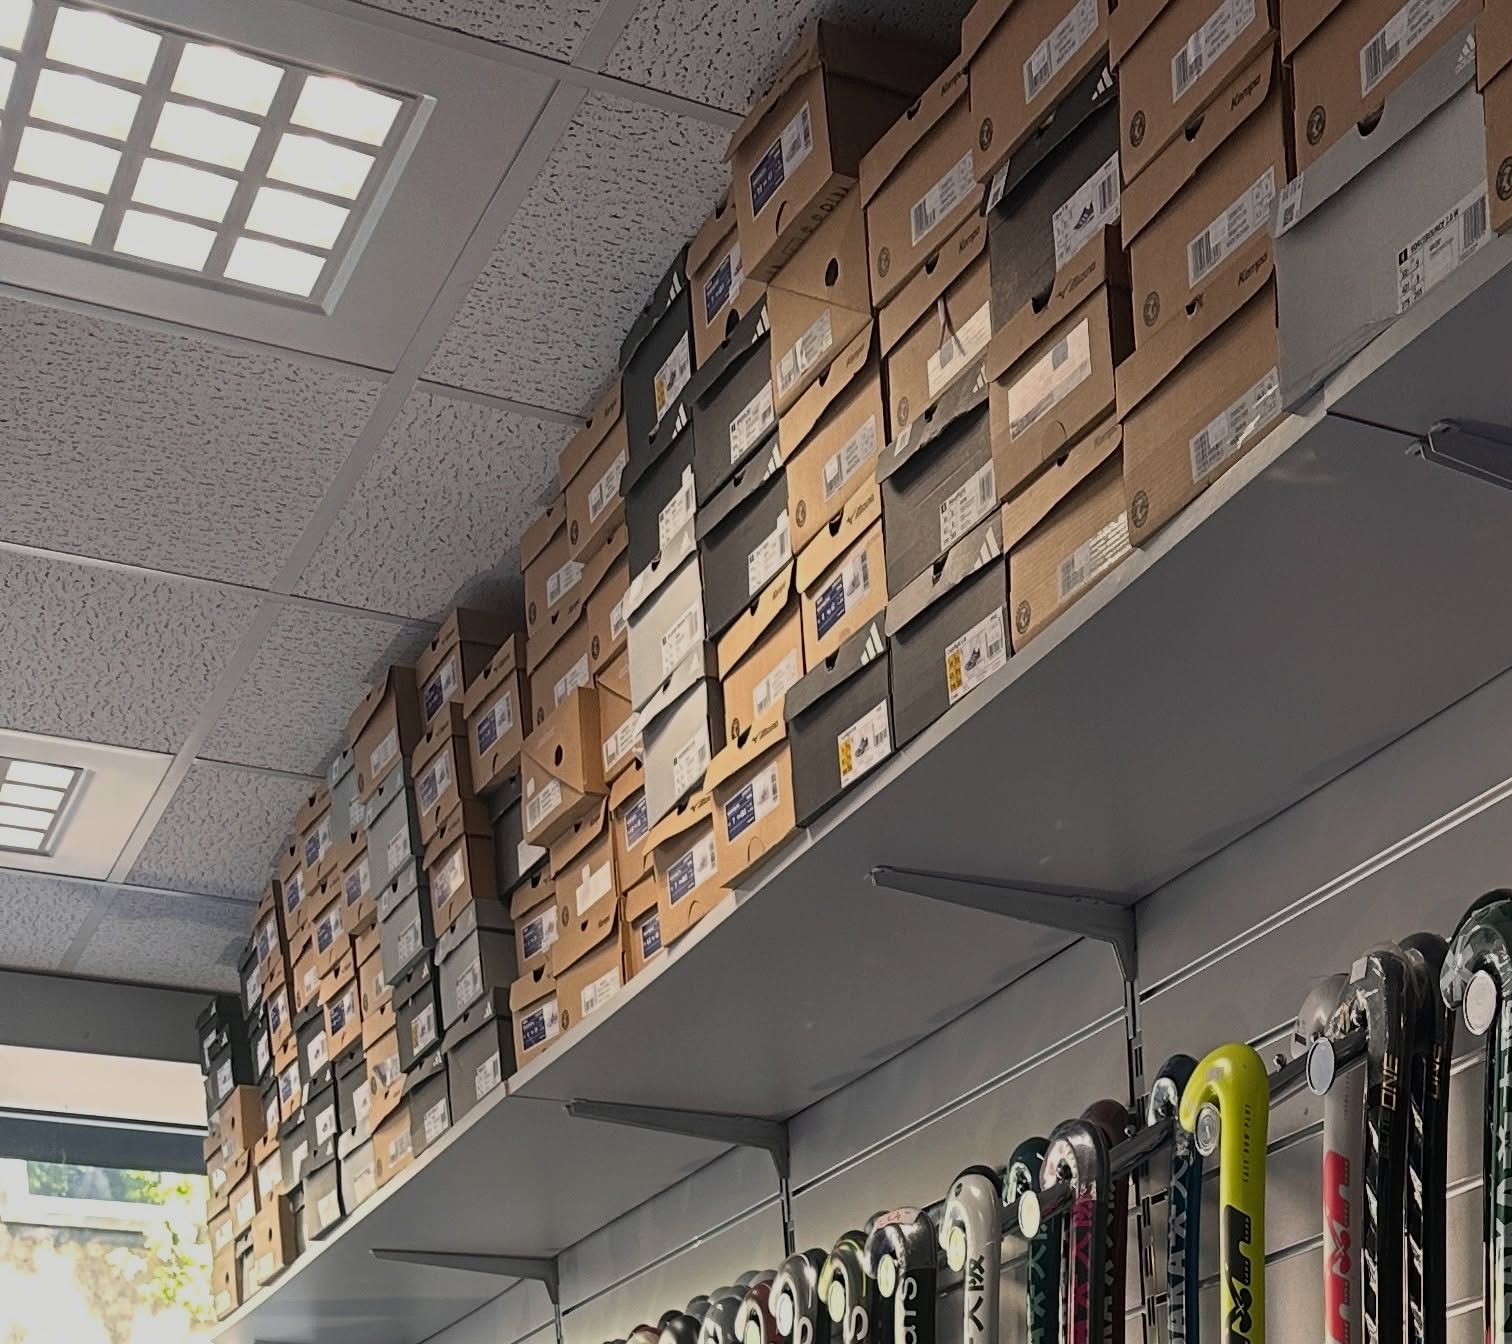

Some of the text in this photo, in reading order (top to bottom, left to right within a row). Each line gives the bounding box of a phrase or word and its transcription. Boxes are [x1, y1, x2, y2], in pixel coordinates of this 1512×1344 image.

[1231, 73, 1262, 112] Kempa
[1237, 252, 1269, 287] Kempa
[1380, 1051, 1398, 1112] ONE
